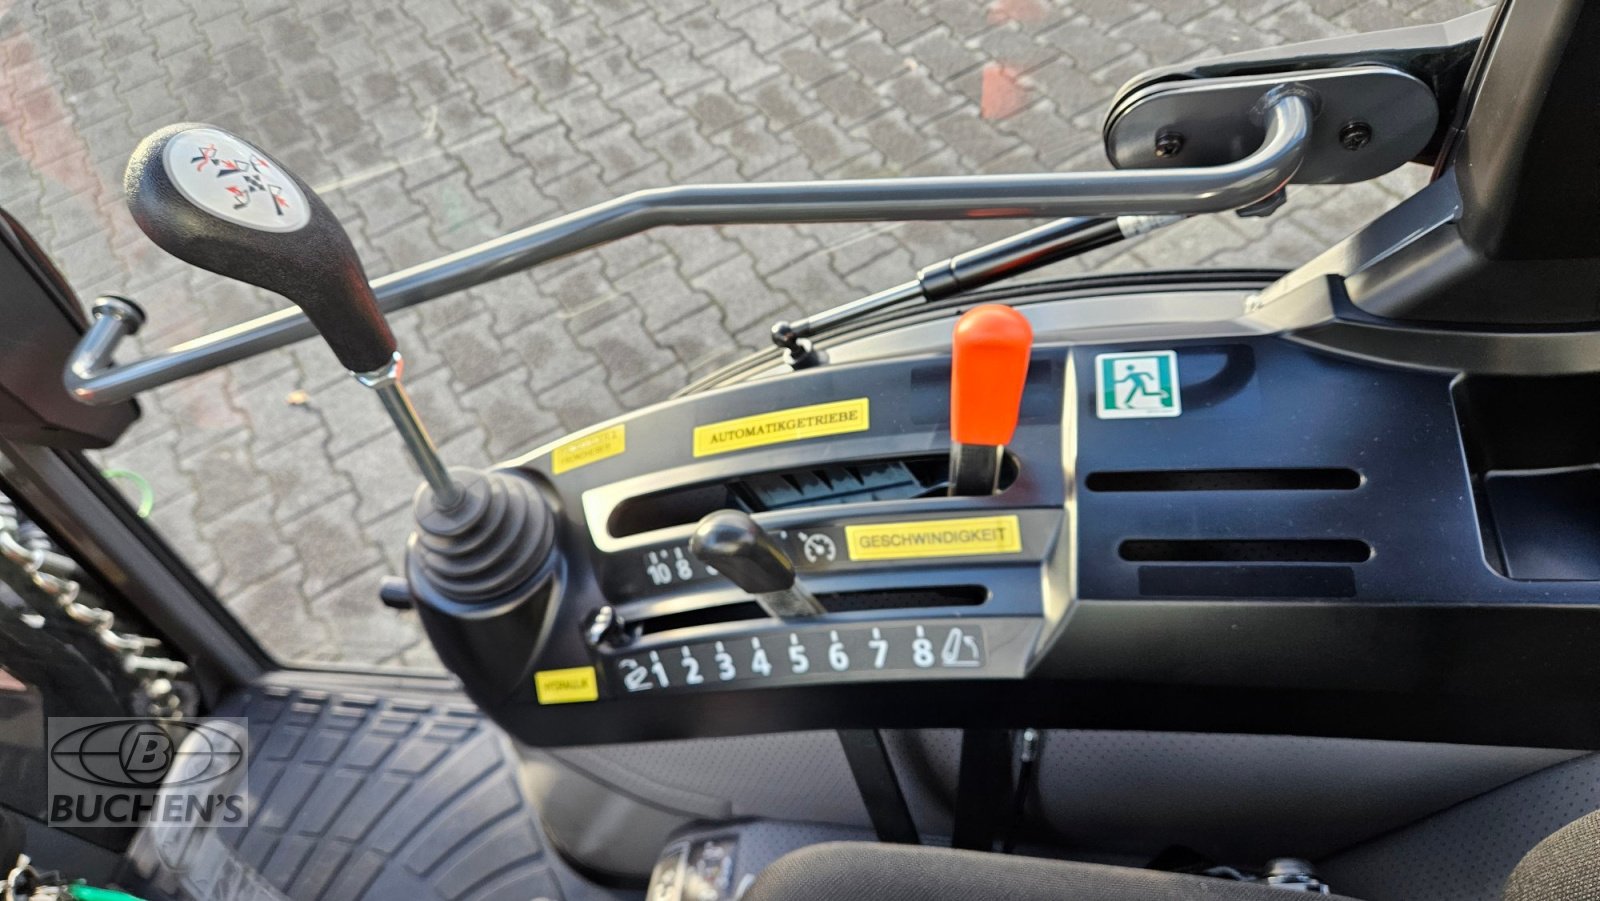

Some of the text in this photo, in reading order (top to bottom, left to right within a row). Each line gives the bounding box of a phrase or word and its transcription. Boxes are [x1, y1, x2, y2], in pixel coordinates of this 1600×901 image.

[709, 409, 859, 445] AUTOMATIKGETRIEBE
[858, 526, 1008, 549] GESCHWINDIGKEIT
[647, 562, 672, 586] 10
[675, 558, 693, 581] 8
[651, 637, 935, 688] 1 2 3 4 5 6 7 8
